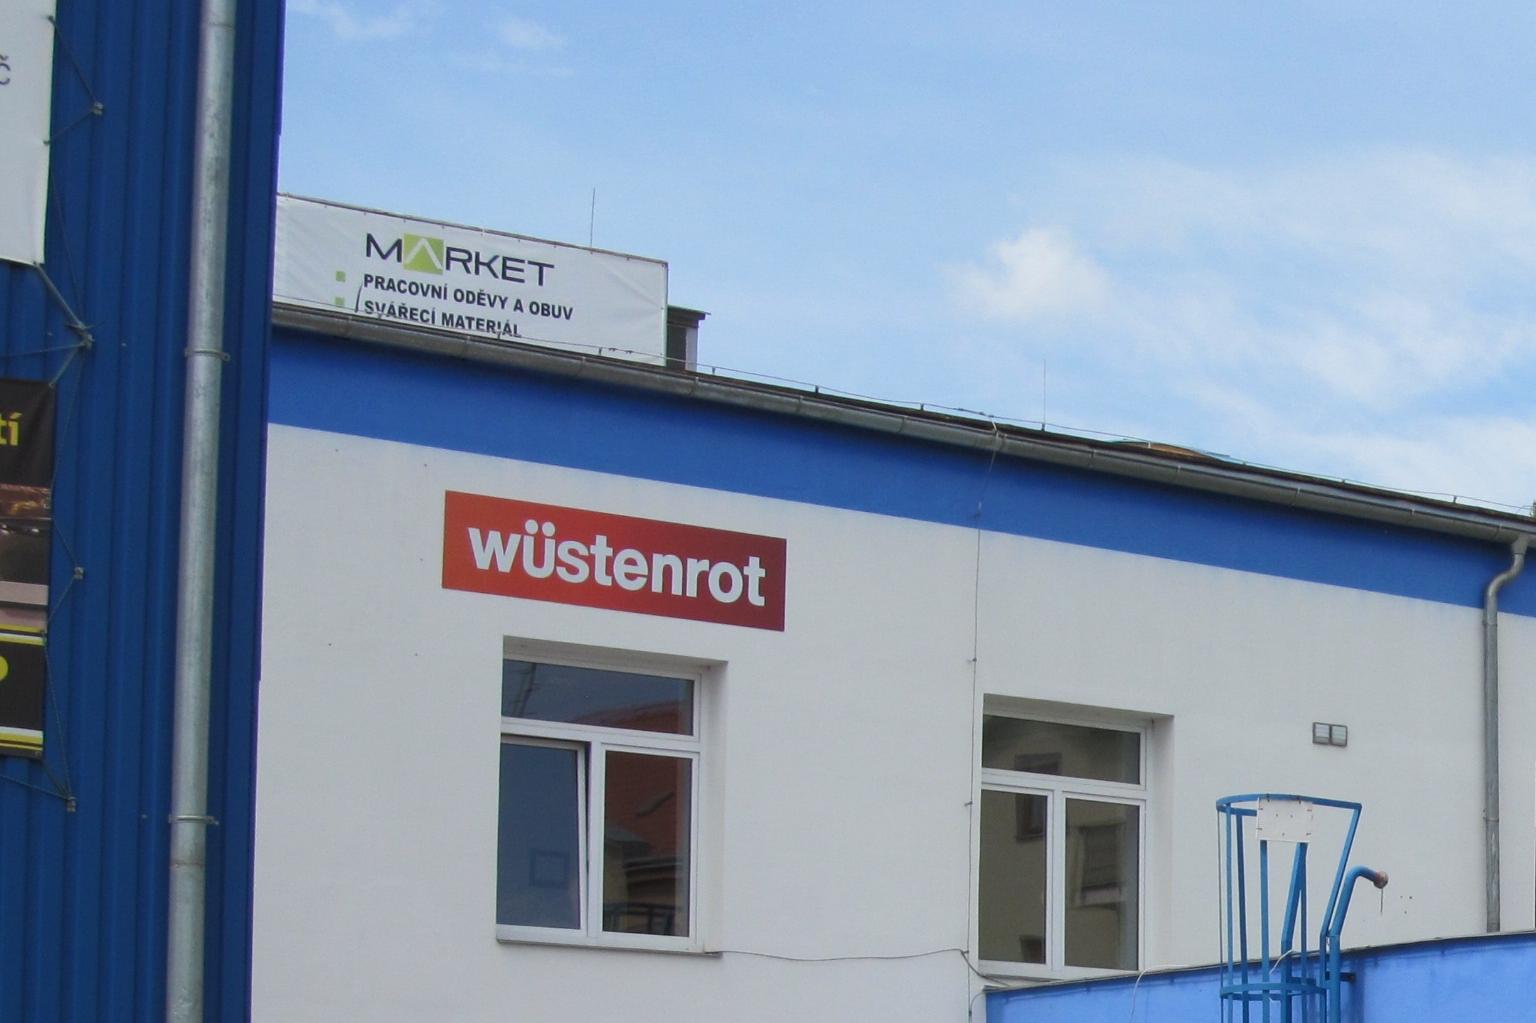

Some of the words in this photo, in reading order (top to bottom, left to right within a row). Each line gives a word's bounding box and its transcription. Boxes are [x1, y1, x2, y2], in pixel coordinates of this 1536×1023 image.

[366, 233, 554, 286] MARKET
[363, 273, 448, 300] PRACOVNÍ
[453, 289, 509, 311] ODĚVY
[513, 299, 524, 313] A
[529, 301, 574, 321] OBUV
[364, 300, 436, 325] SVÁŘECÍ
[441, 312, 522, 338] MATERIÁL
[468, 519, 766, 607] wüstenrot
